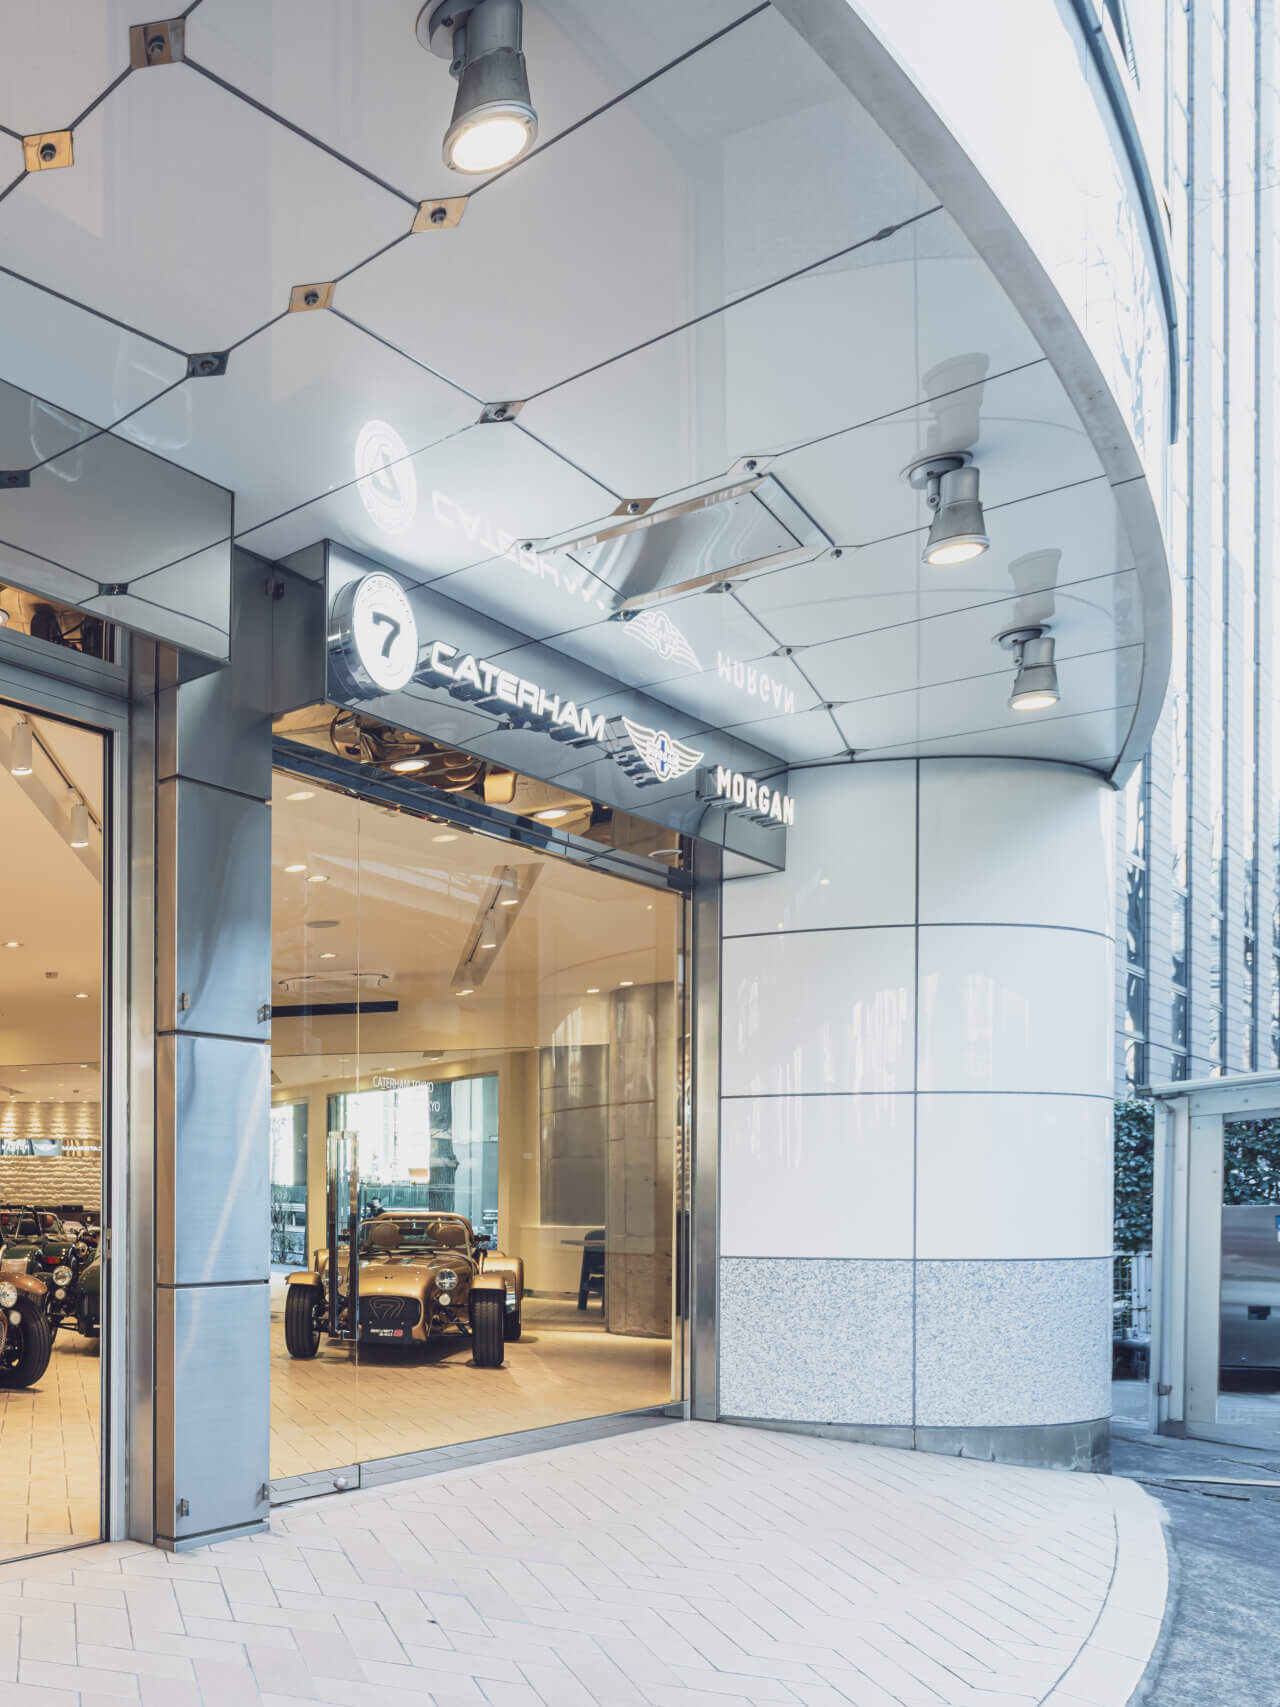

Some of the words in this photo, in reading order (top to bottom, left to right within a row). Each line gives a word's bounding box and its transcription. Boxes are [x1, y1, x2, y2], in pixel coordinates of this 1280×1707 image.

[371, 610, 401, 658] 7
[431, 640, 606, 742] CATERHAM
[716, 765, 795, 826] MORGAN
